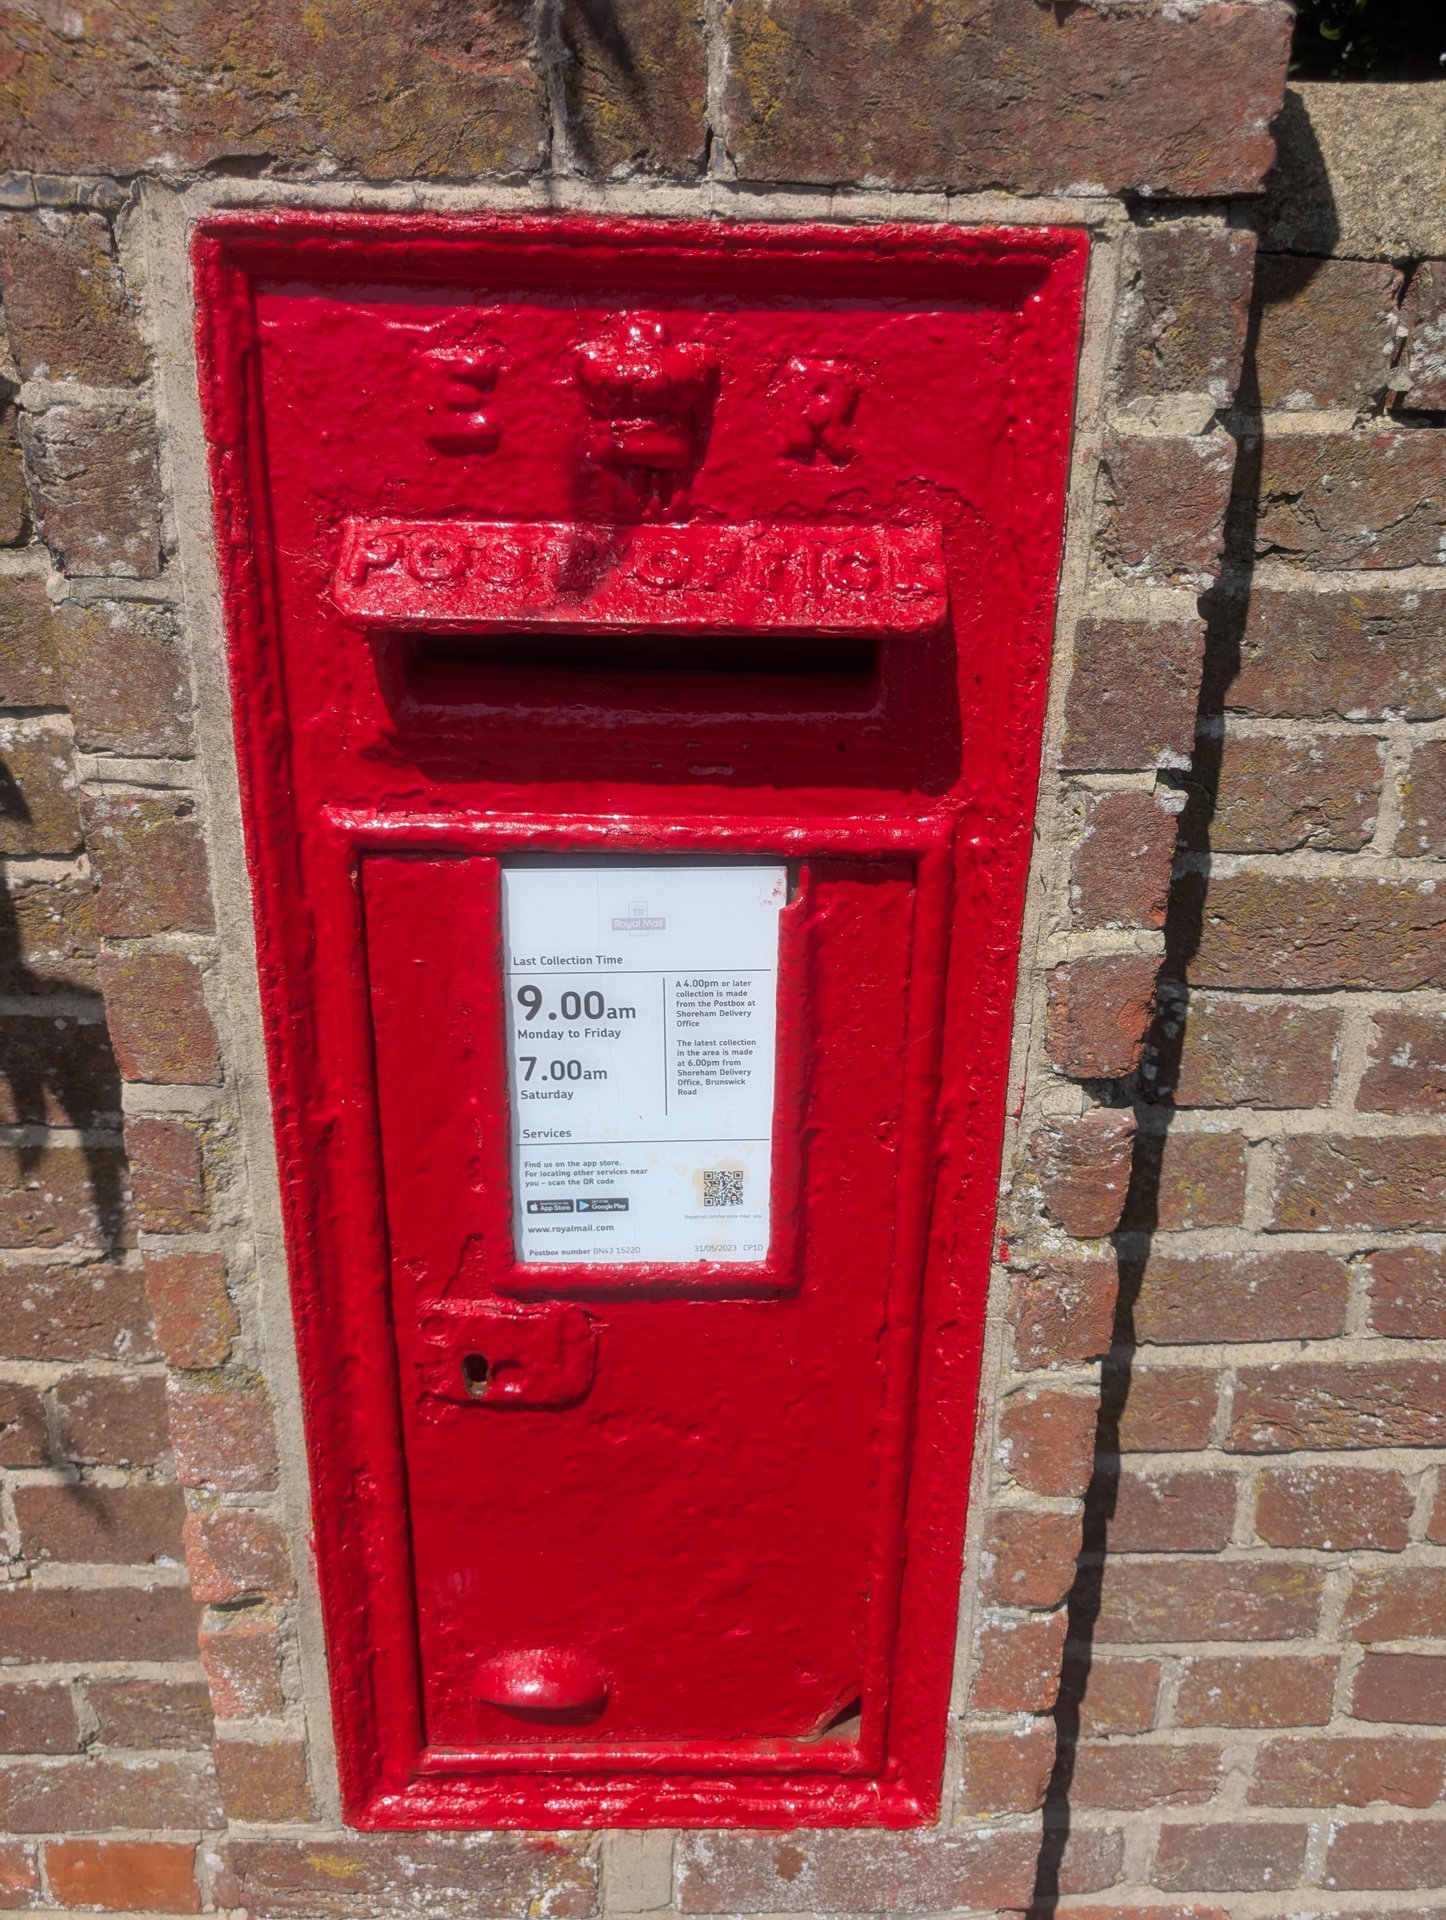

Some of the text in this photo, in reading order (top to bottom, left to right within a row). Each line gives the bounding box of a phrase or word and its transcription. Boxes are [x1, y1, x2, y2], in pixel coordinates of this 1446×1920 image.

[614, 919, 663, 929] Royal Mail
[513, 955, 623, 965] Last Collection Time
[684, 979, 718, 988] 4.00pm
[733, 980, 752, 988] later
[676, 990, 748, 998] collection is made
[517, 985, 636, 1021] 9.00am
[720, 1010, 752, 1018] Delivery
[677, 1020, 700, 1028] Office
[518, 1028, 621, 1040] Monday to Friday
[719, 1039, 757, 1047] collection
[688, 1059, 720, 1068] 6.00pm
[519, 1056, 607, 1081] 7.00am
[720, 1069, 752, 1077] Delivery
[678, 1079, 703, 1087] Office,
[521, 1090, 574, 1100] Saturday
[523, 1129, 572, 1138] Services
[540, 1170, 572, 1178] locating
[525, 1181, 540, 1189] you
[554, 1204, 572, 1212] Store
[528, 1225, 615, 1234] www.royalmail.com
[530, 1249, 559, 1257] Postbox
[694, 1245, 737, 1253] 31/05/2023
